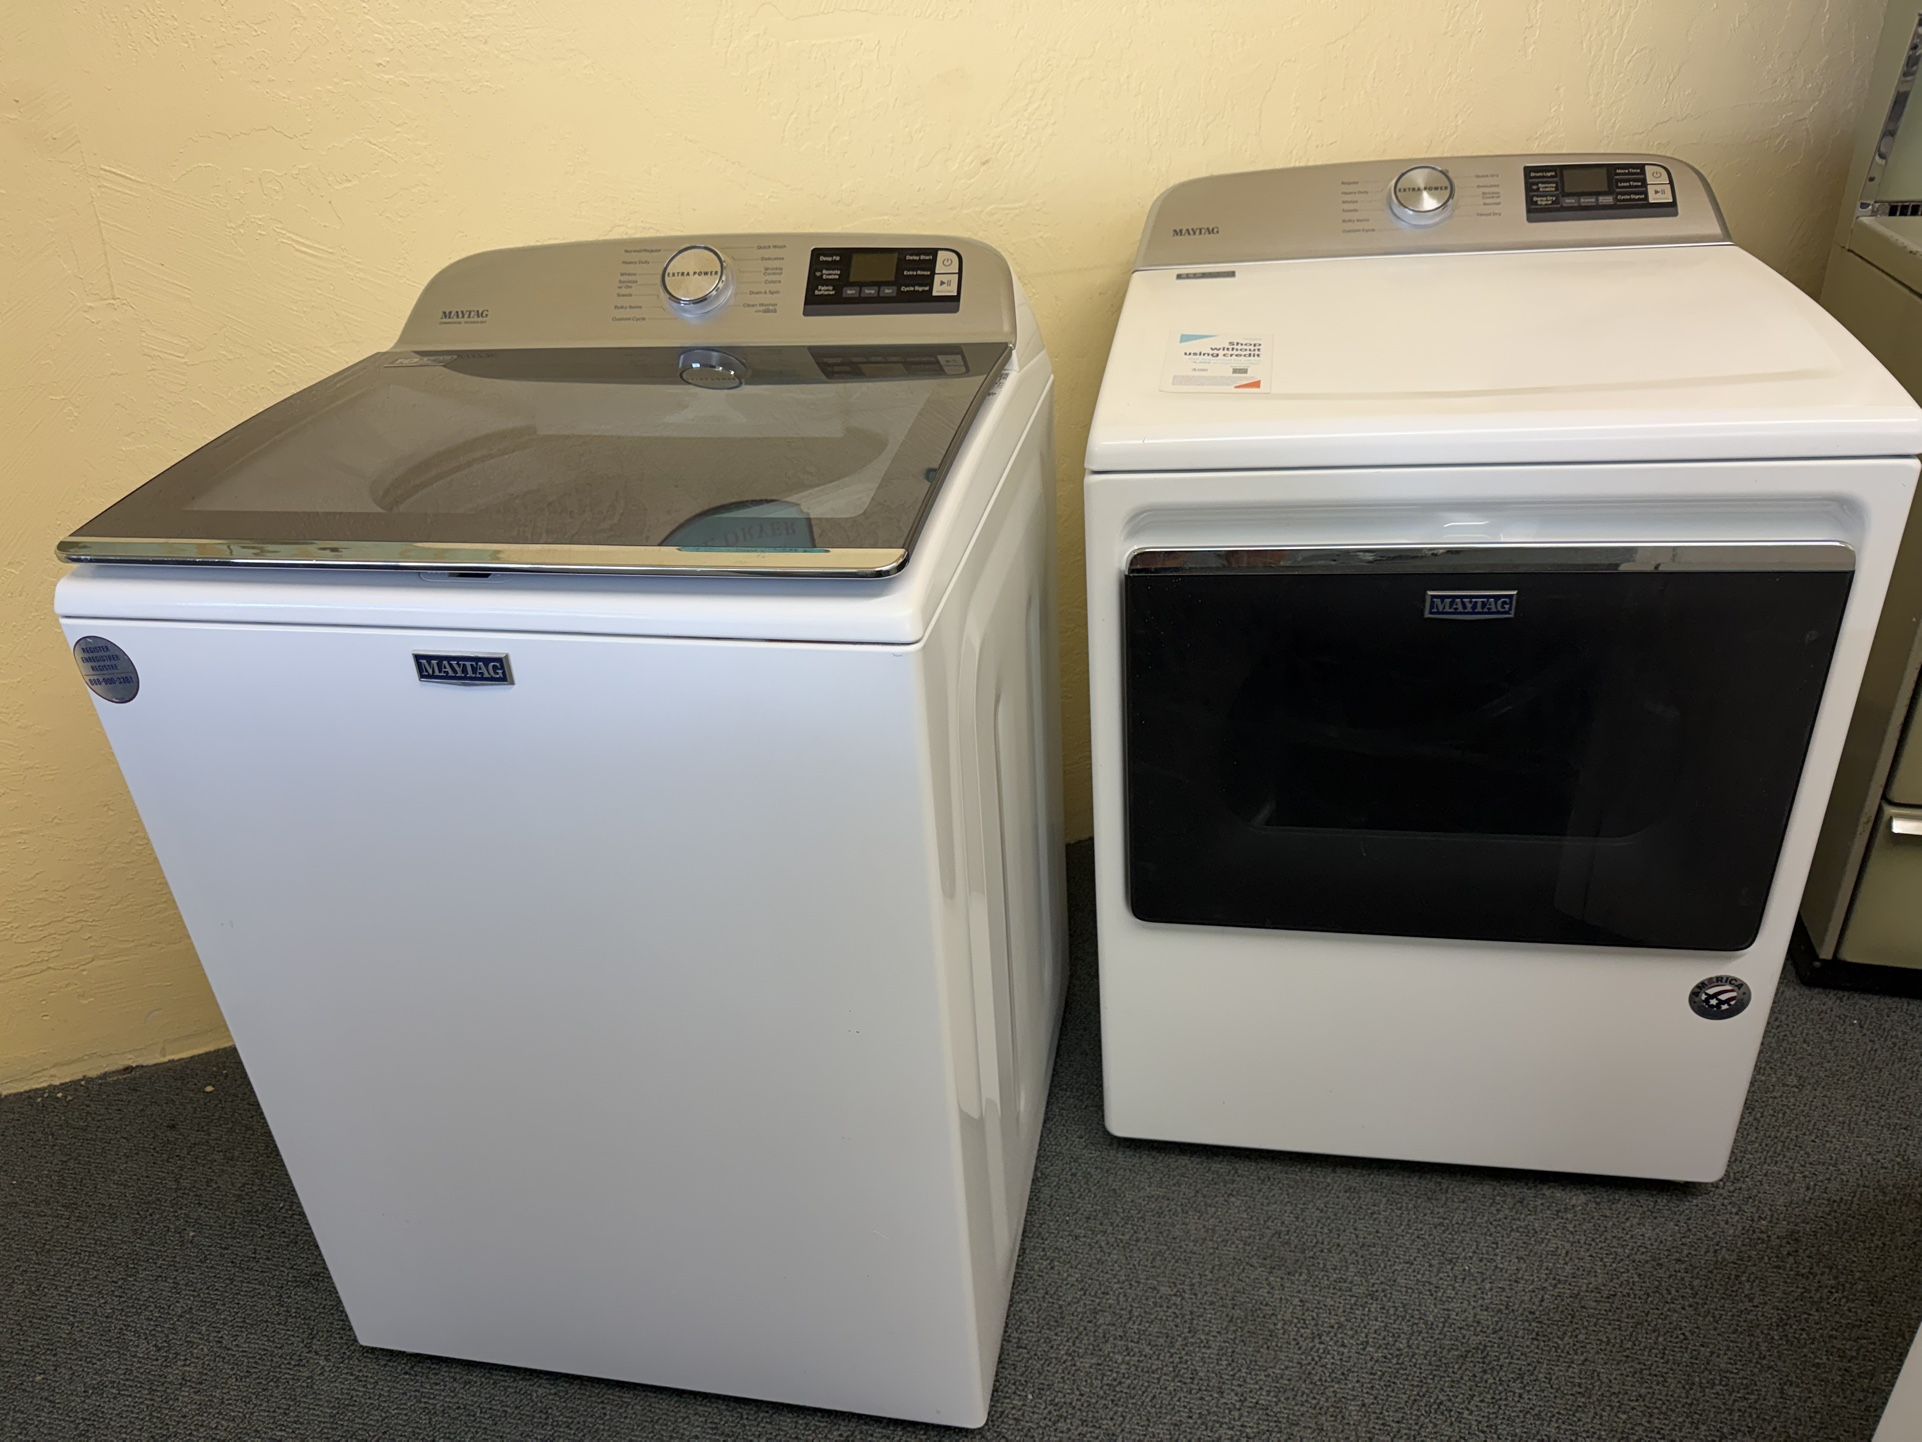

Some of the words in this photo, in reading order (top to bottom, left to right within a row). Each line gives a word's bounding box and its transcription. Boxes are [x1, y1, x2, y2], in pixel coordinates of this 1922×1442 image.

[1172, 226, 1220, 237] MAYTAG
[440, 309, 489, 320] MAYTAG
[1432, 598, 1510, 612] MAYTAG
[419, 660, 504, 678] MAYTAG
[1692, 976, 1744, 998] AMERICA
